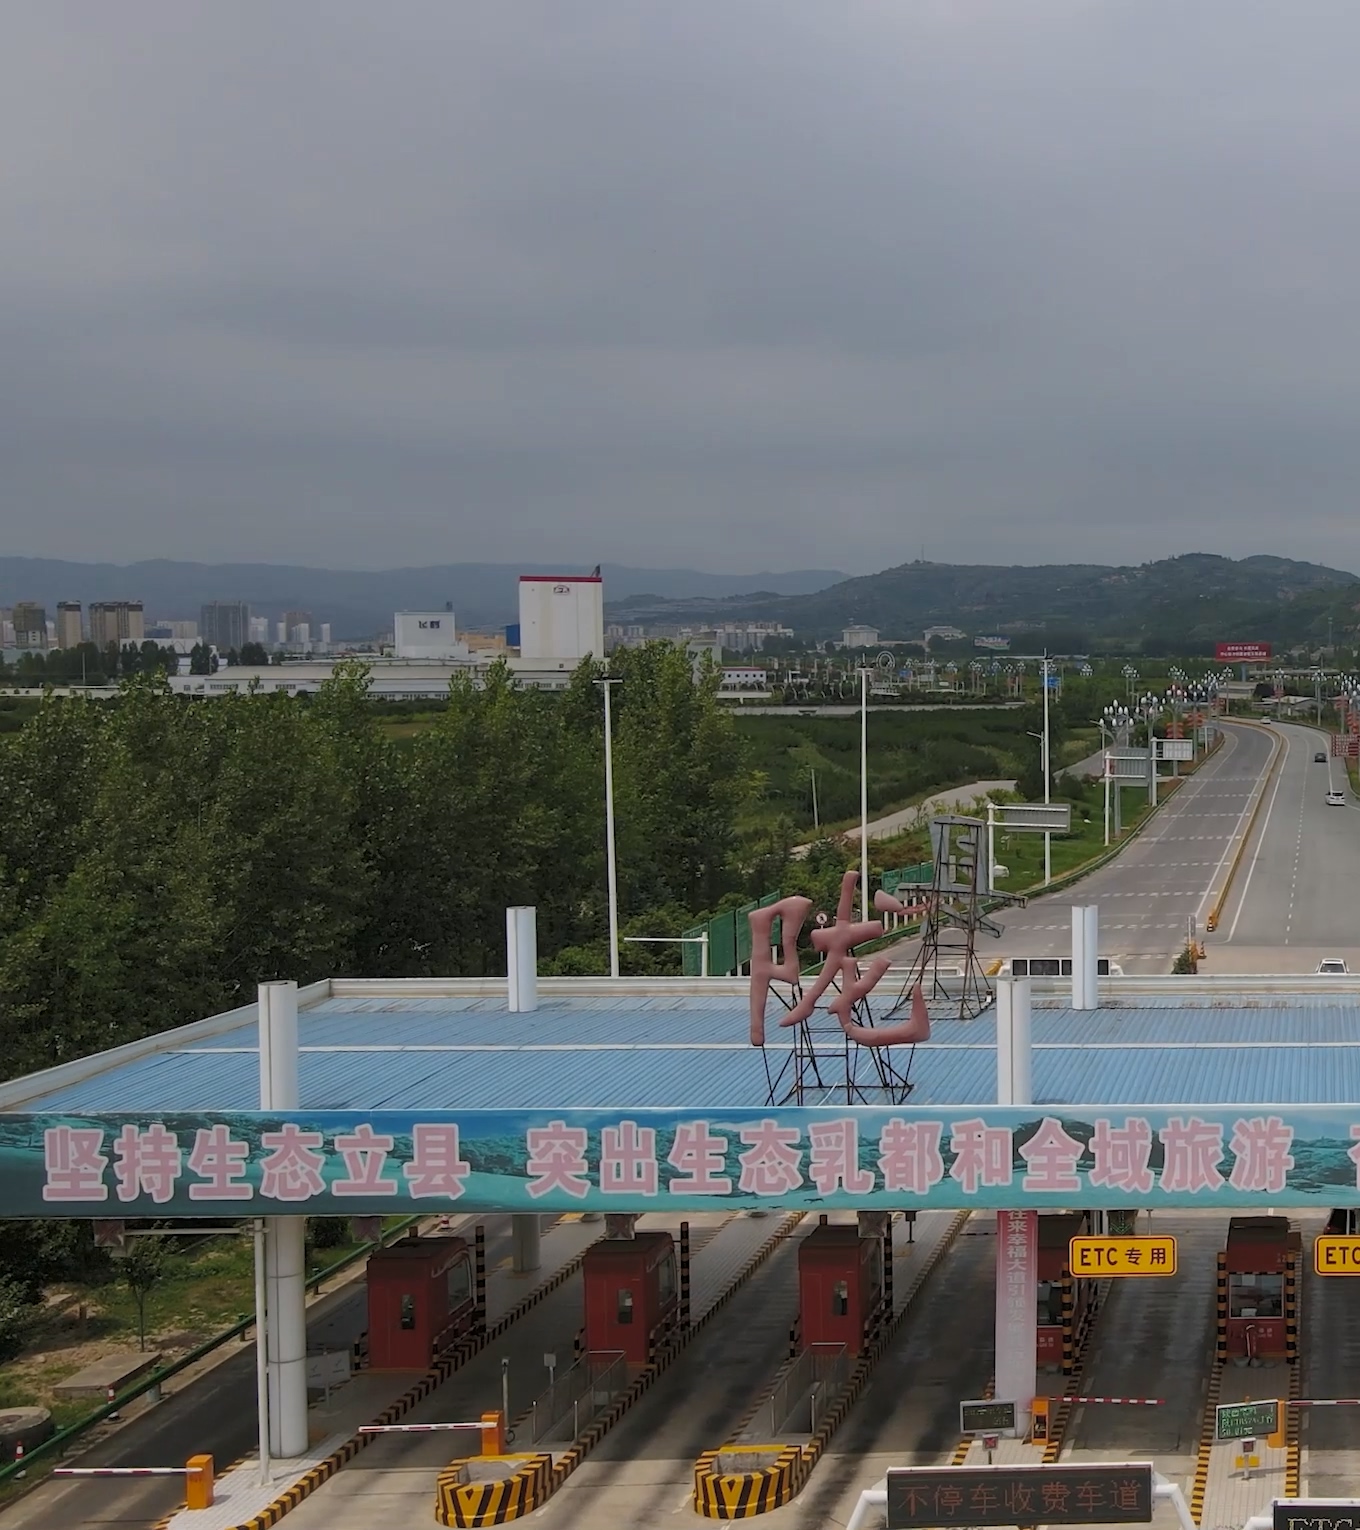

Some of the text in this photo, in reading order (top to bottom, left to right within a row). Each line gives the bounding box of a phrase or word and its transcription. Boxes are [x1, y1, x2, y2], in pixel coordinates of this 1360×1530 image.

[42, 1122, 470, 1202] 坚持生态立县
[526, 1117, 1293, 1197] 突出生态乳都和全域旅游
[1081, 1247, 1167, 1266] ETC 专用
[897, 1480, 1142, 1516] 不停车收费车道
